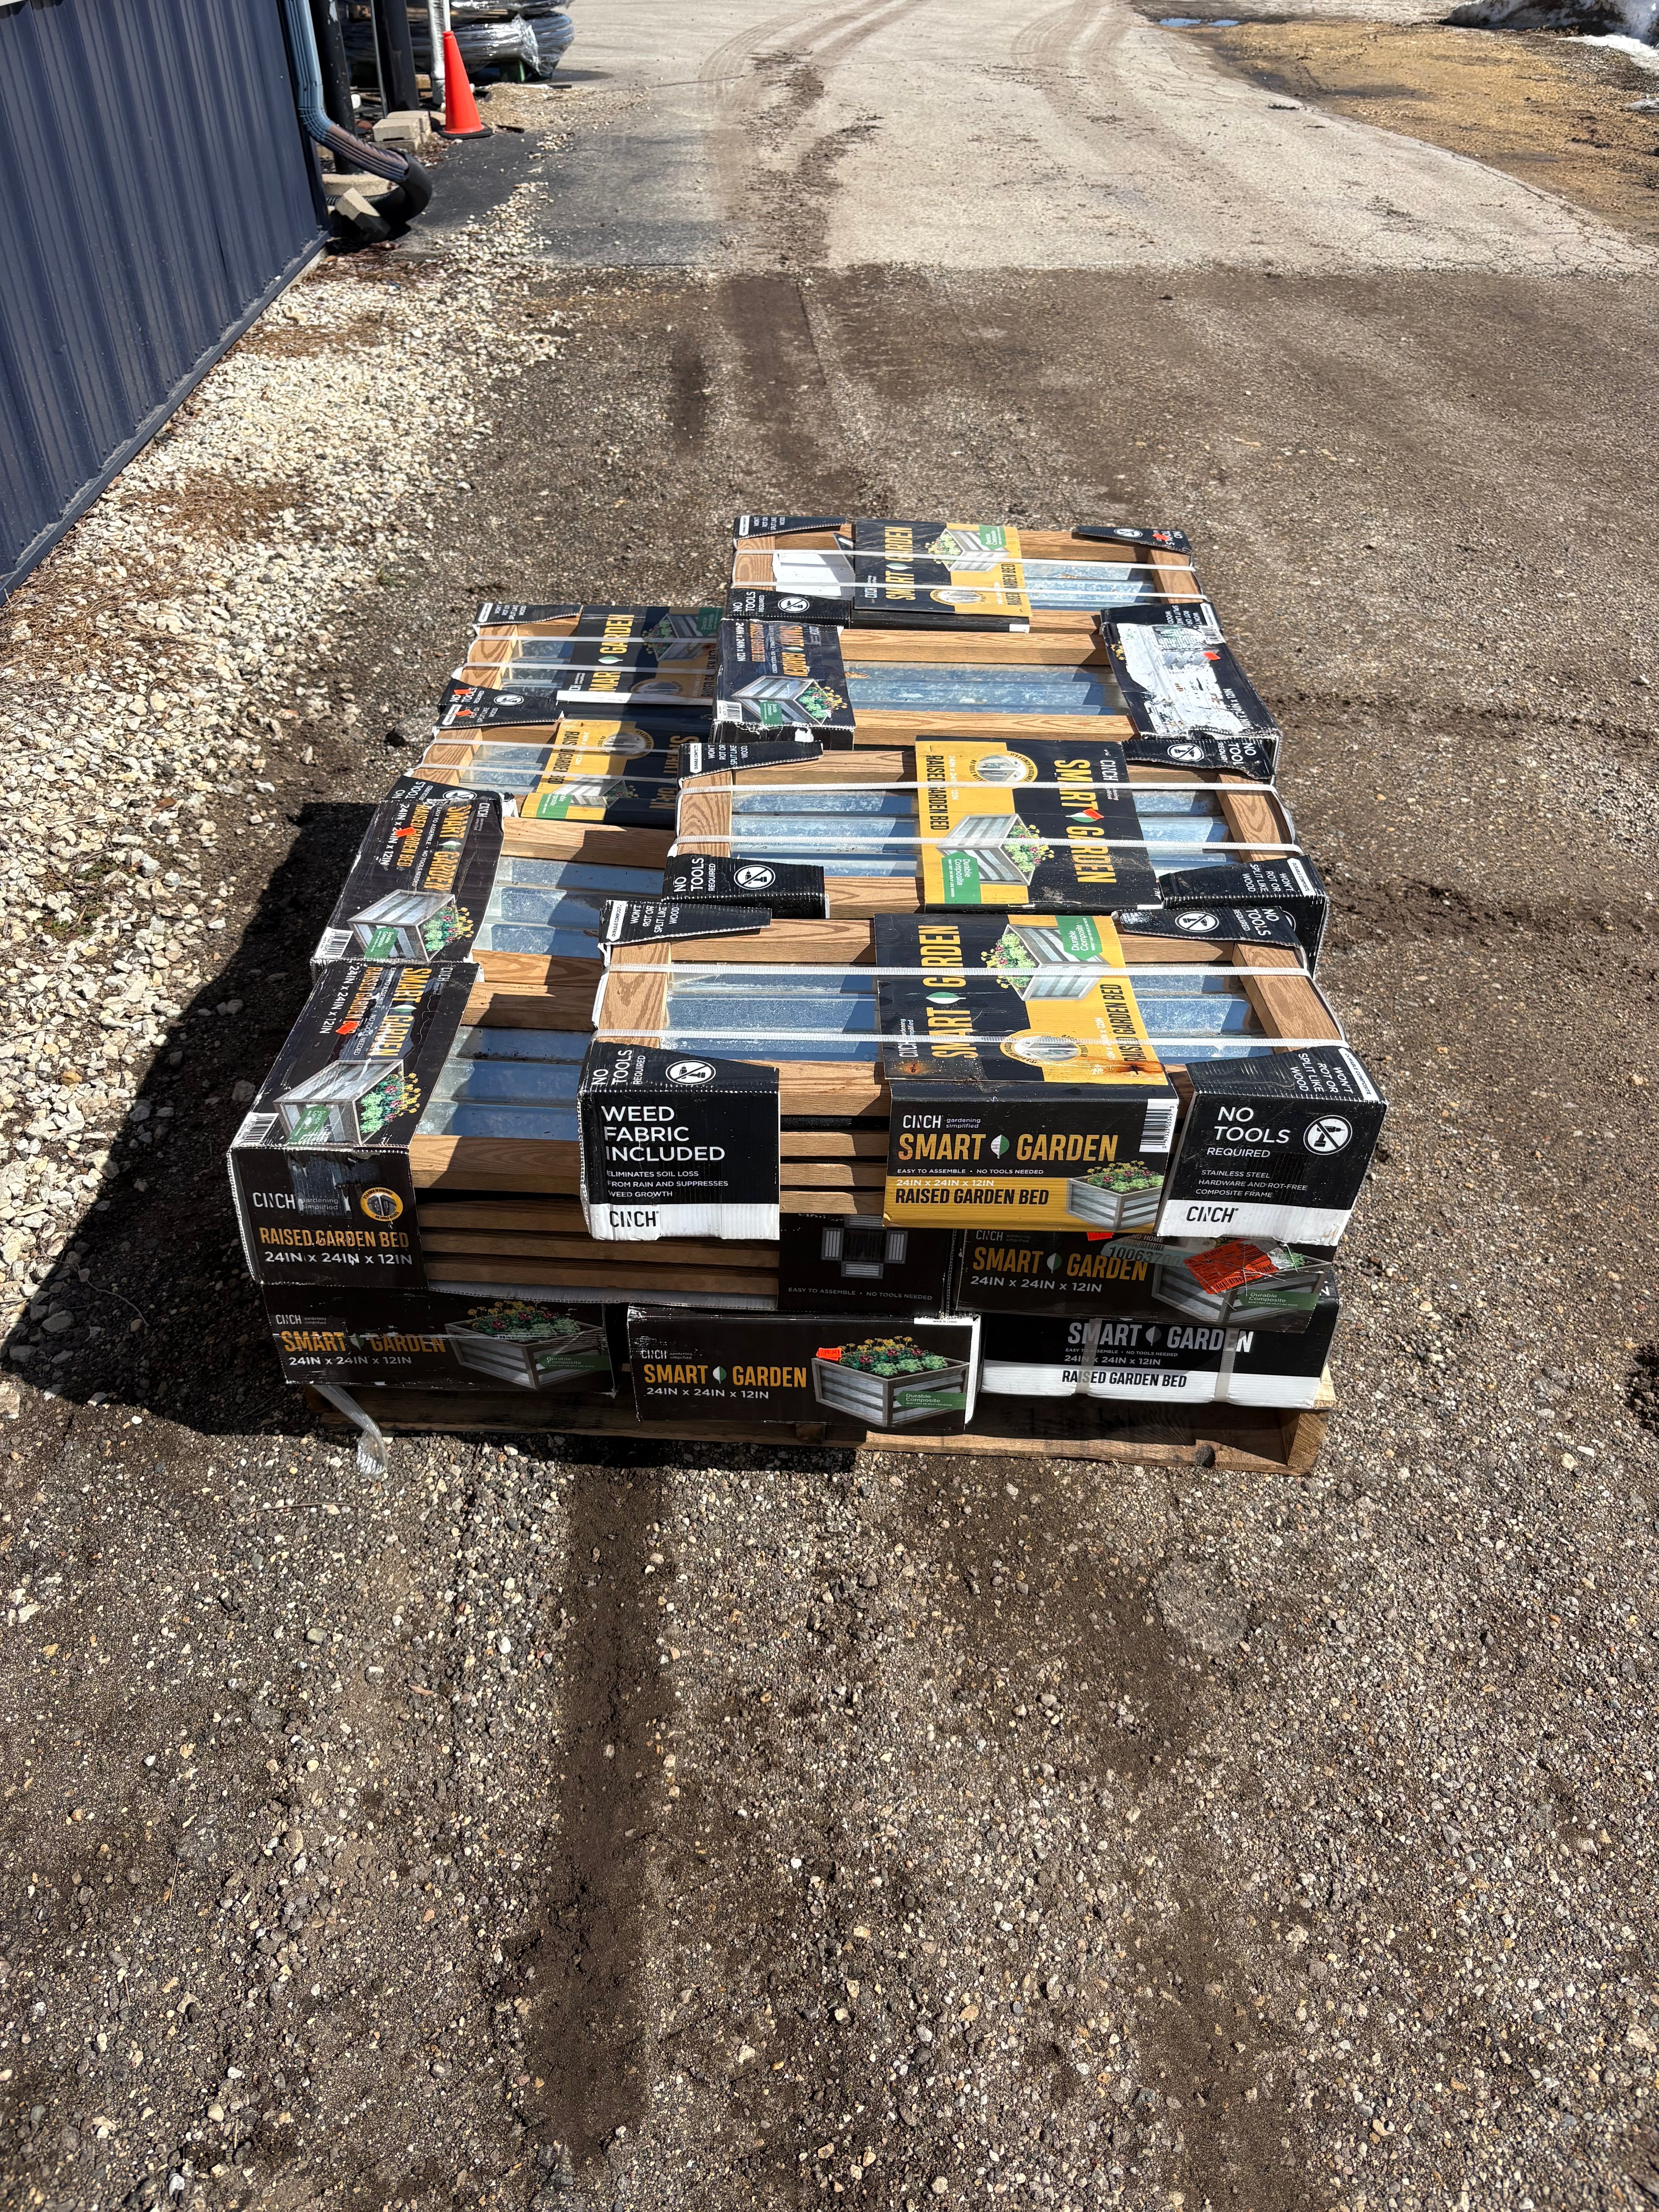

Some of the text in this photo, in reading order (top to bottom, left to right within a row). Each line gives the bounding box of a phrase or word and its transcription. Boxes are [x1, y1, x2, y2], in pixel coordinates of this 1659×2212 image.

[733, 601, 743, 612] NO
[746, 591, 756, 612] TOOLS
[1165, 611, 1174, 624] WOOD
[782, 652, 808, 676] GARDEN
[1242, 743, 1256, 756] NO
[1100, 760, 1118, 781] CINCH
[392, 790, 405, 798] NO
[405, 782, 426, 799] TOOLS
[397, 804, 430, 867] RAISED GARDEN BED
[426, 823, 435, 845] ASSEMBLE
[424, 805, 472, 890] SMART GARDEN
[415, 857, 425, 873] TOOLS
[691, 858, 704, 891] TOOLS
[954, 859, 964, 885] Composite
[963, 859, 972, 877] Durable
[674, 877, 686, 892] NO
[1242, 874, 1255, 892] WOOD
[1250, 864, 1268, 892] SPLIT LIKE
[1265, 871, 1281, 892] ROT OR
[643, 906, 655, 926] ROT OR
[654, 907, 667, 933] SPLIT LIKE
[669, 907, 679, 924] WOOD
[1232, 909, 1250, 931] REQUIRED
[1246, 909, 1271, 936] TOOLS
[1262, 909, 1279, 921] NO
[1068, 931, 1080, 950] Durable
[1076, 925, 1088, 951] Composite
[359, 967, 383, 991] RAISED
[345, 993, 372, 1019] GARDEN
[368, 968, 432, 1056] SMART GARDEN
[592, 1069, 608, 1085] NO
[612, 1050, 632, 1085] TOOLS
[633, 1055, 645, 1084] REQUIRED
[1298, 1053, 1324, 1092] SPLIT LIKE
[1290, 1067, 1309, 1091] WOOD
[1318, 1063, 1338, 1093] ROT OR
[1333, 1067, 1353, 1093] WON'T
[601, 1106, 674, 1122] WEED
[903, 1115, 941, 1128] CINCH
[1217, 1106, 1253, 1122] NO
[604, 1126, 690, 1142] FABRIC
[1214, 1126, 1290, 1144] TOOLS
[606, 1146, 725, 1161] INCLUDED
[898, 1133, 1118, 1161] SMART GARDEN
[1207, 1147, 1271, 1158] REQUIRED
[895, 1188, 1049, 1205] RAISED GARDEN BED
[1268, 1182, 1308, 1191] ROT-FREE
[252, 1192, 296, 1209] CINCH
[259, 1227, 409, 1248] RAISED GARDEN BED
[1144, 1235, 1164, 1243] HOME
[264, 1252, 302, 1262] 24IN
[321, 1252, 359, 1264] 24IN
[378, 1254, 412, 1265] 12IN
[973, 1246, 1147, 1281] SMART GARDEN
[970, 1276, 1004, 1287] 24IN
[1020, 1279, 1055, 1290] 24IN
[1072, 1282, 1102, 1292] 12IN
[280, 1331, 446, 1353] SMART GARDEN
[1068, 1322, 1254, 1353] SMART GARDEN
[289, 1357, 321, 1366] 24IN
[644, 1364, 807, 1388] SMART GARDEN
[1062, 1370, 1187, 1387] RAISED GARDEN BED
[647, 1387, 677, 1395] 24IN
[694, 1389, 725, 1397] 24IN
[741, 1390, 769, 1399] 12IN
